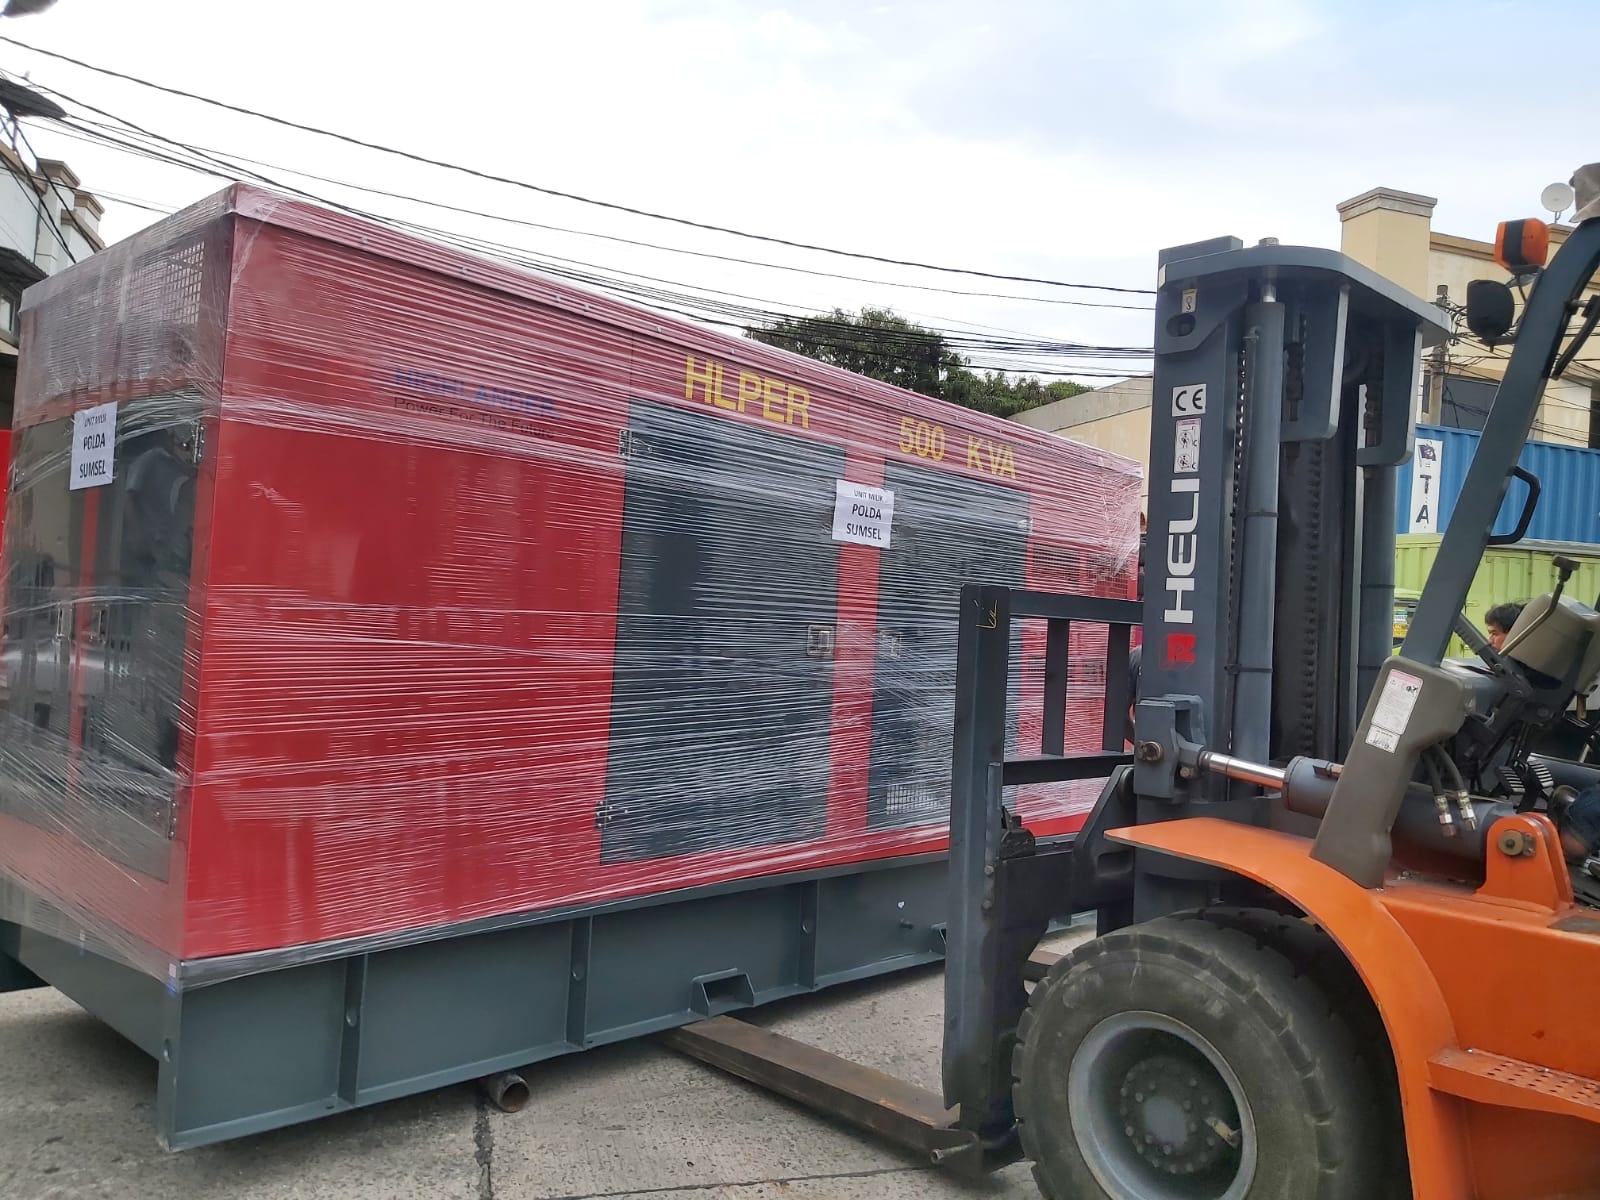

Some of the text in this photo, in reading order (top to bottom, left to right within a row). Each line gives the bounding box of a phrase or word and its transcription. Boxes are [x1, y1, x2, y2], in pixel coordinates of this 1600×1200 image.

[685, 356, 812, 429] HLPER
[1175, 388, 1204, 412] CE
[394, 396, 443, 415] Power
[450, 407, 474, 421] For
[480, 413, 506, 430] The
[83, 432, 106, 452] POLDA
[899, 416, 1017, 481] 500 KVA
[79, 459, 106, 479] SUMSEL
[851, 503, 882, 521] POLDA
[846, 522, 882, 541] SUMSEL
[1163, 478, 1200, 624] HELI
